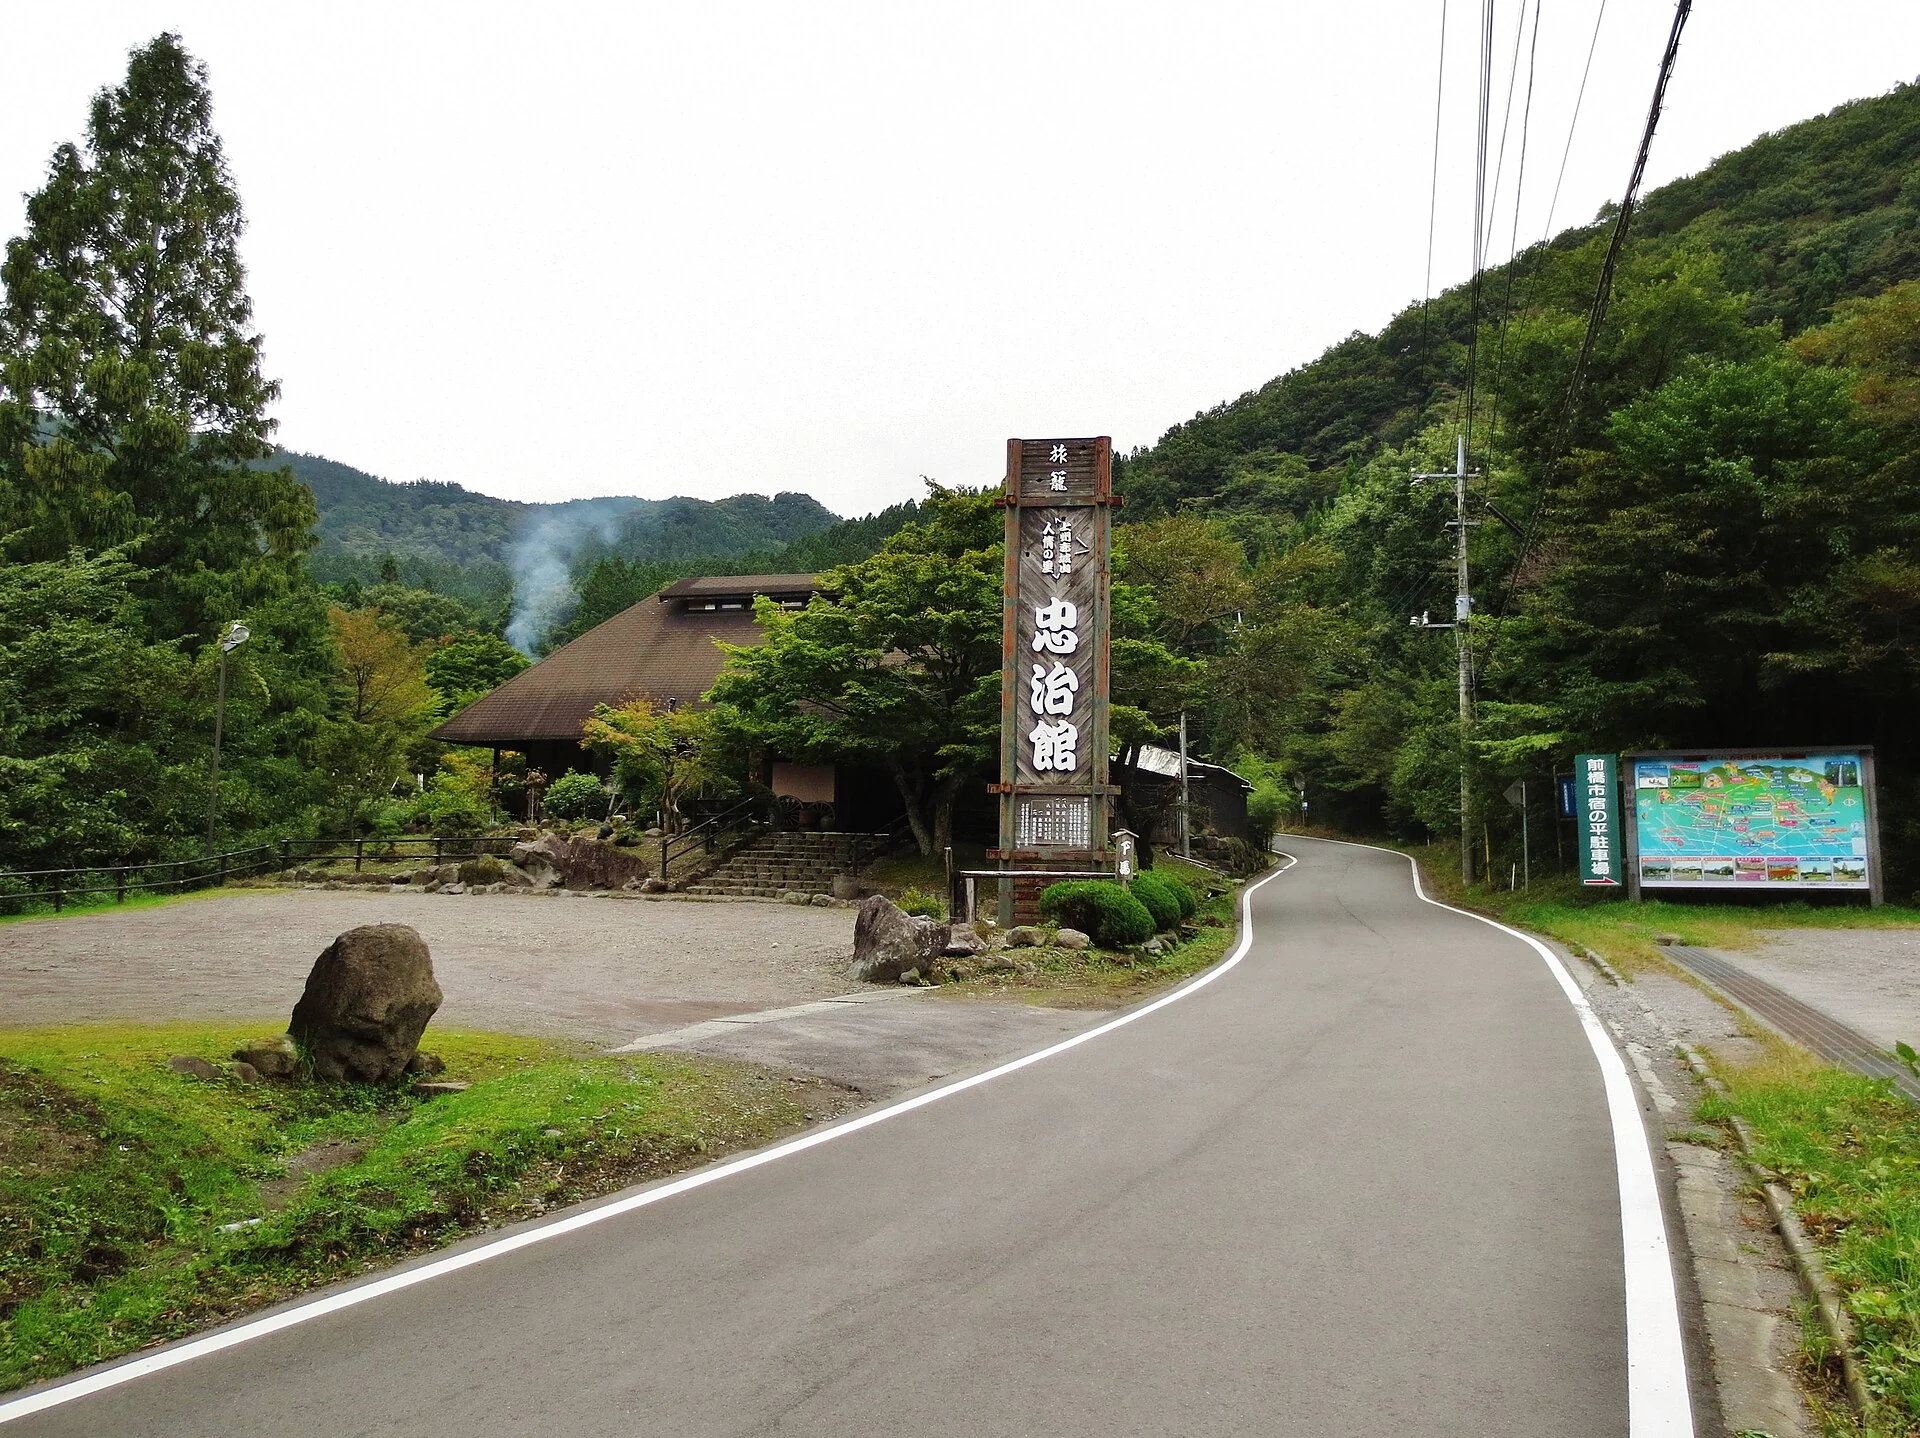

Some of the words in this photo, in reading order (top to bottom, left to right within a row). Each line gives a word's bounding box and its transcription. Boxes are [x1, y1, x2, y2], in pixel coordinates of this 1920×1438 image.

[1049, 443, 1068, 492] 旅籠
[1041, 521, 1056, 574] 人情の里
[1059, 521, 1072, 574] 上州赤城山
[1029, 597, 1079, 771] 忠治館
[1586, 759, 1610, 875] 前橋市宿の平駐車場
[1119, 840, 1131, 875] 下馬
